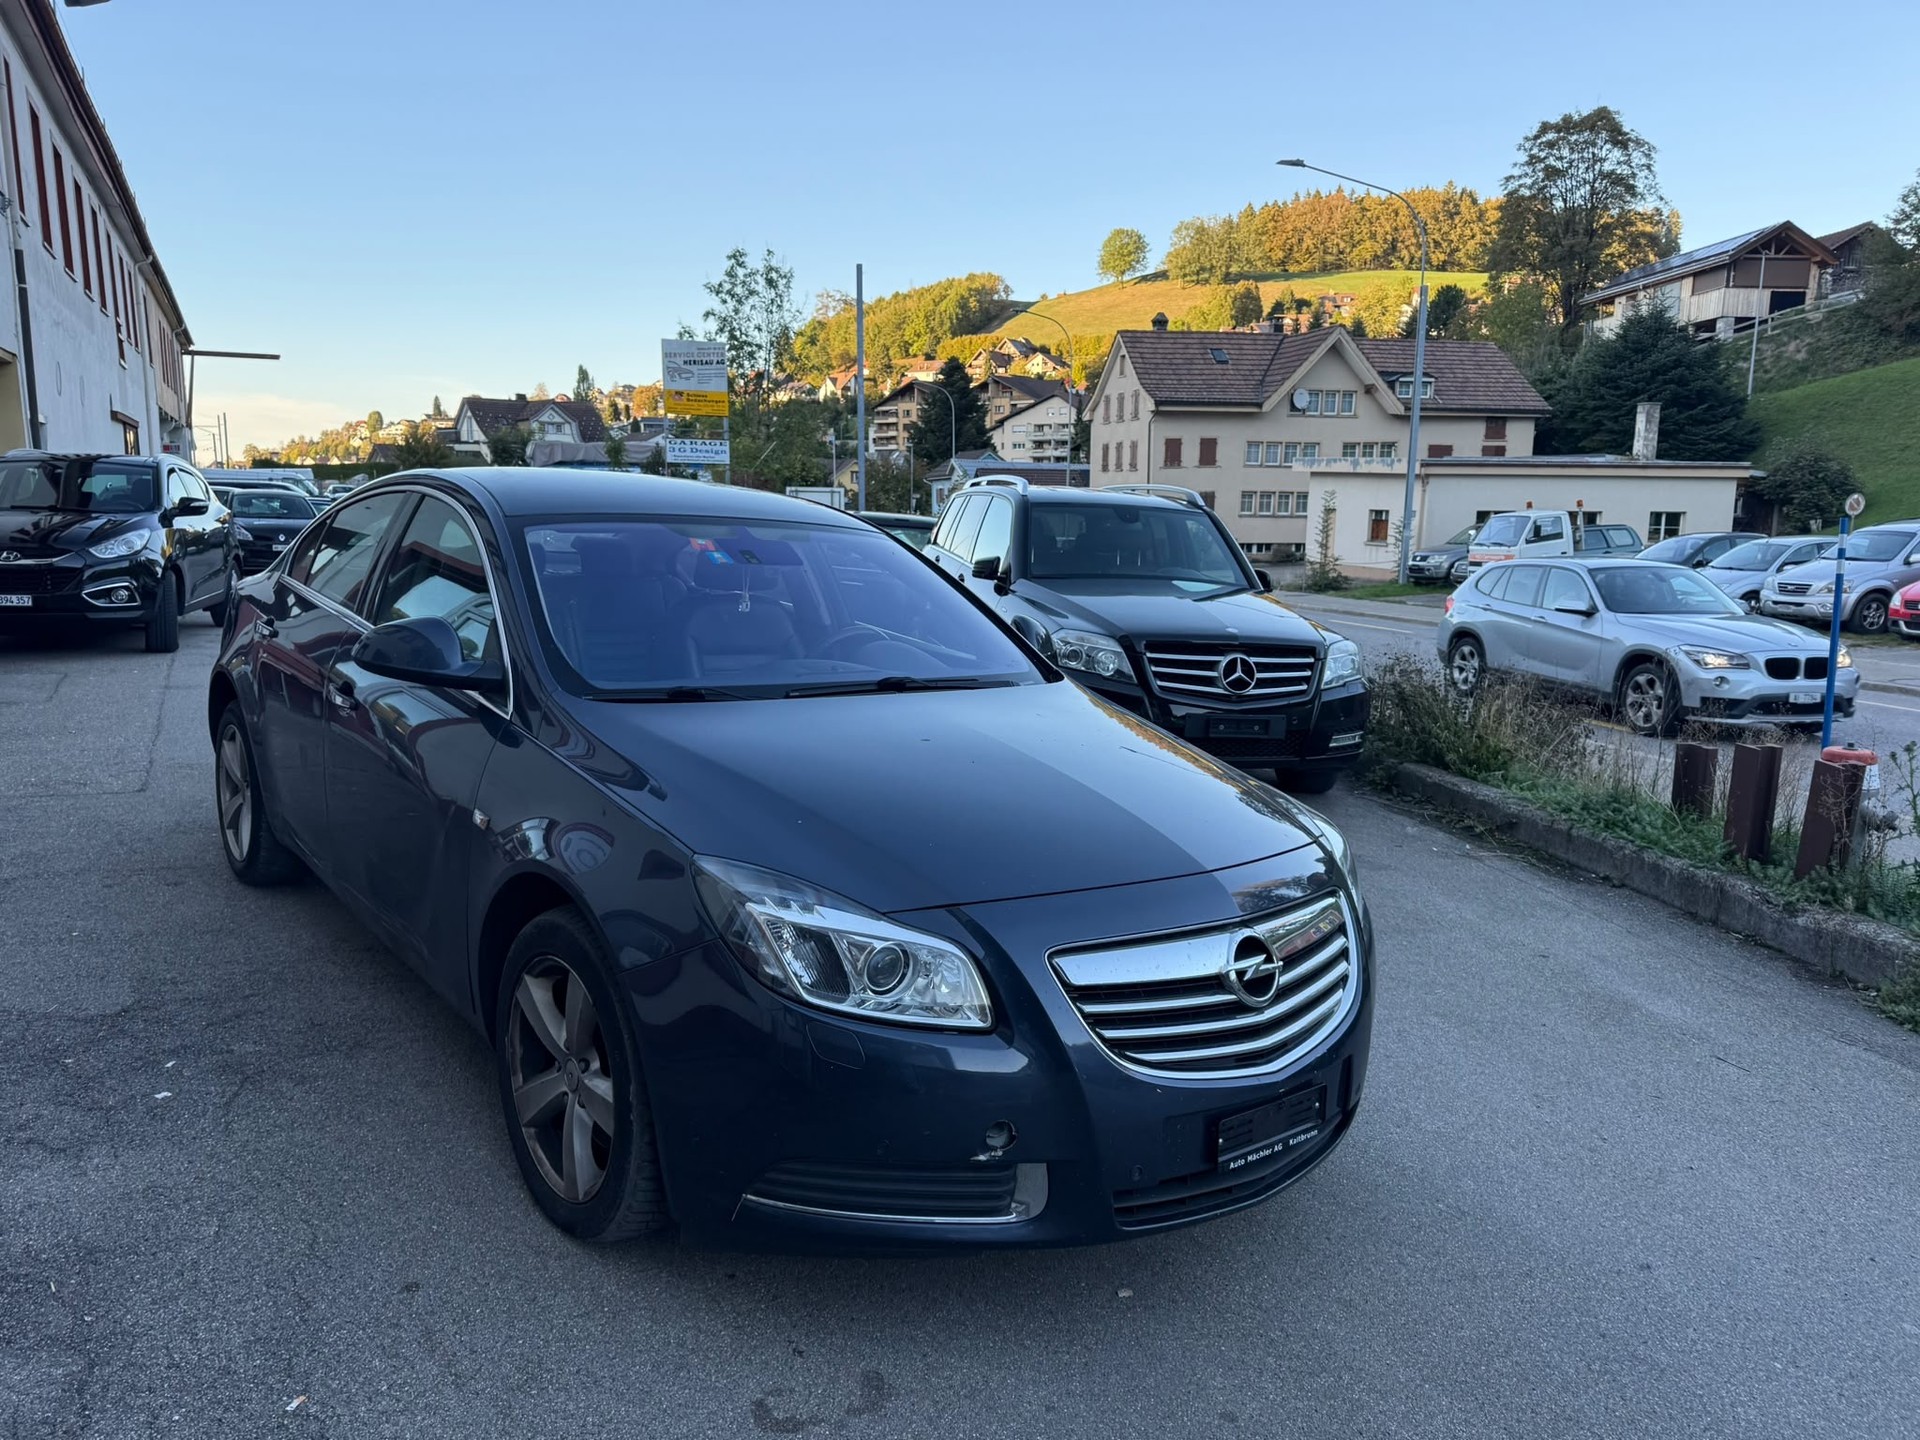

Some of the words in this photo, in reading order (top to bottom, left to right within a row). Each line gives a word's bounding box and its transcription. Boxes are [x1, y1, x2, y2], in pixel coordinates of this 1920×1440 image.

[690, 447, 727, 455] Design
[16, 596, 31, 604] 357
[1229, 1159, 1246, 1170] Auto
[1247, 1148, 1273, 1163] Mächler
[1273, 1143, 1283, 1153] AG
